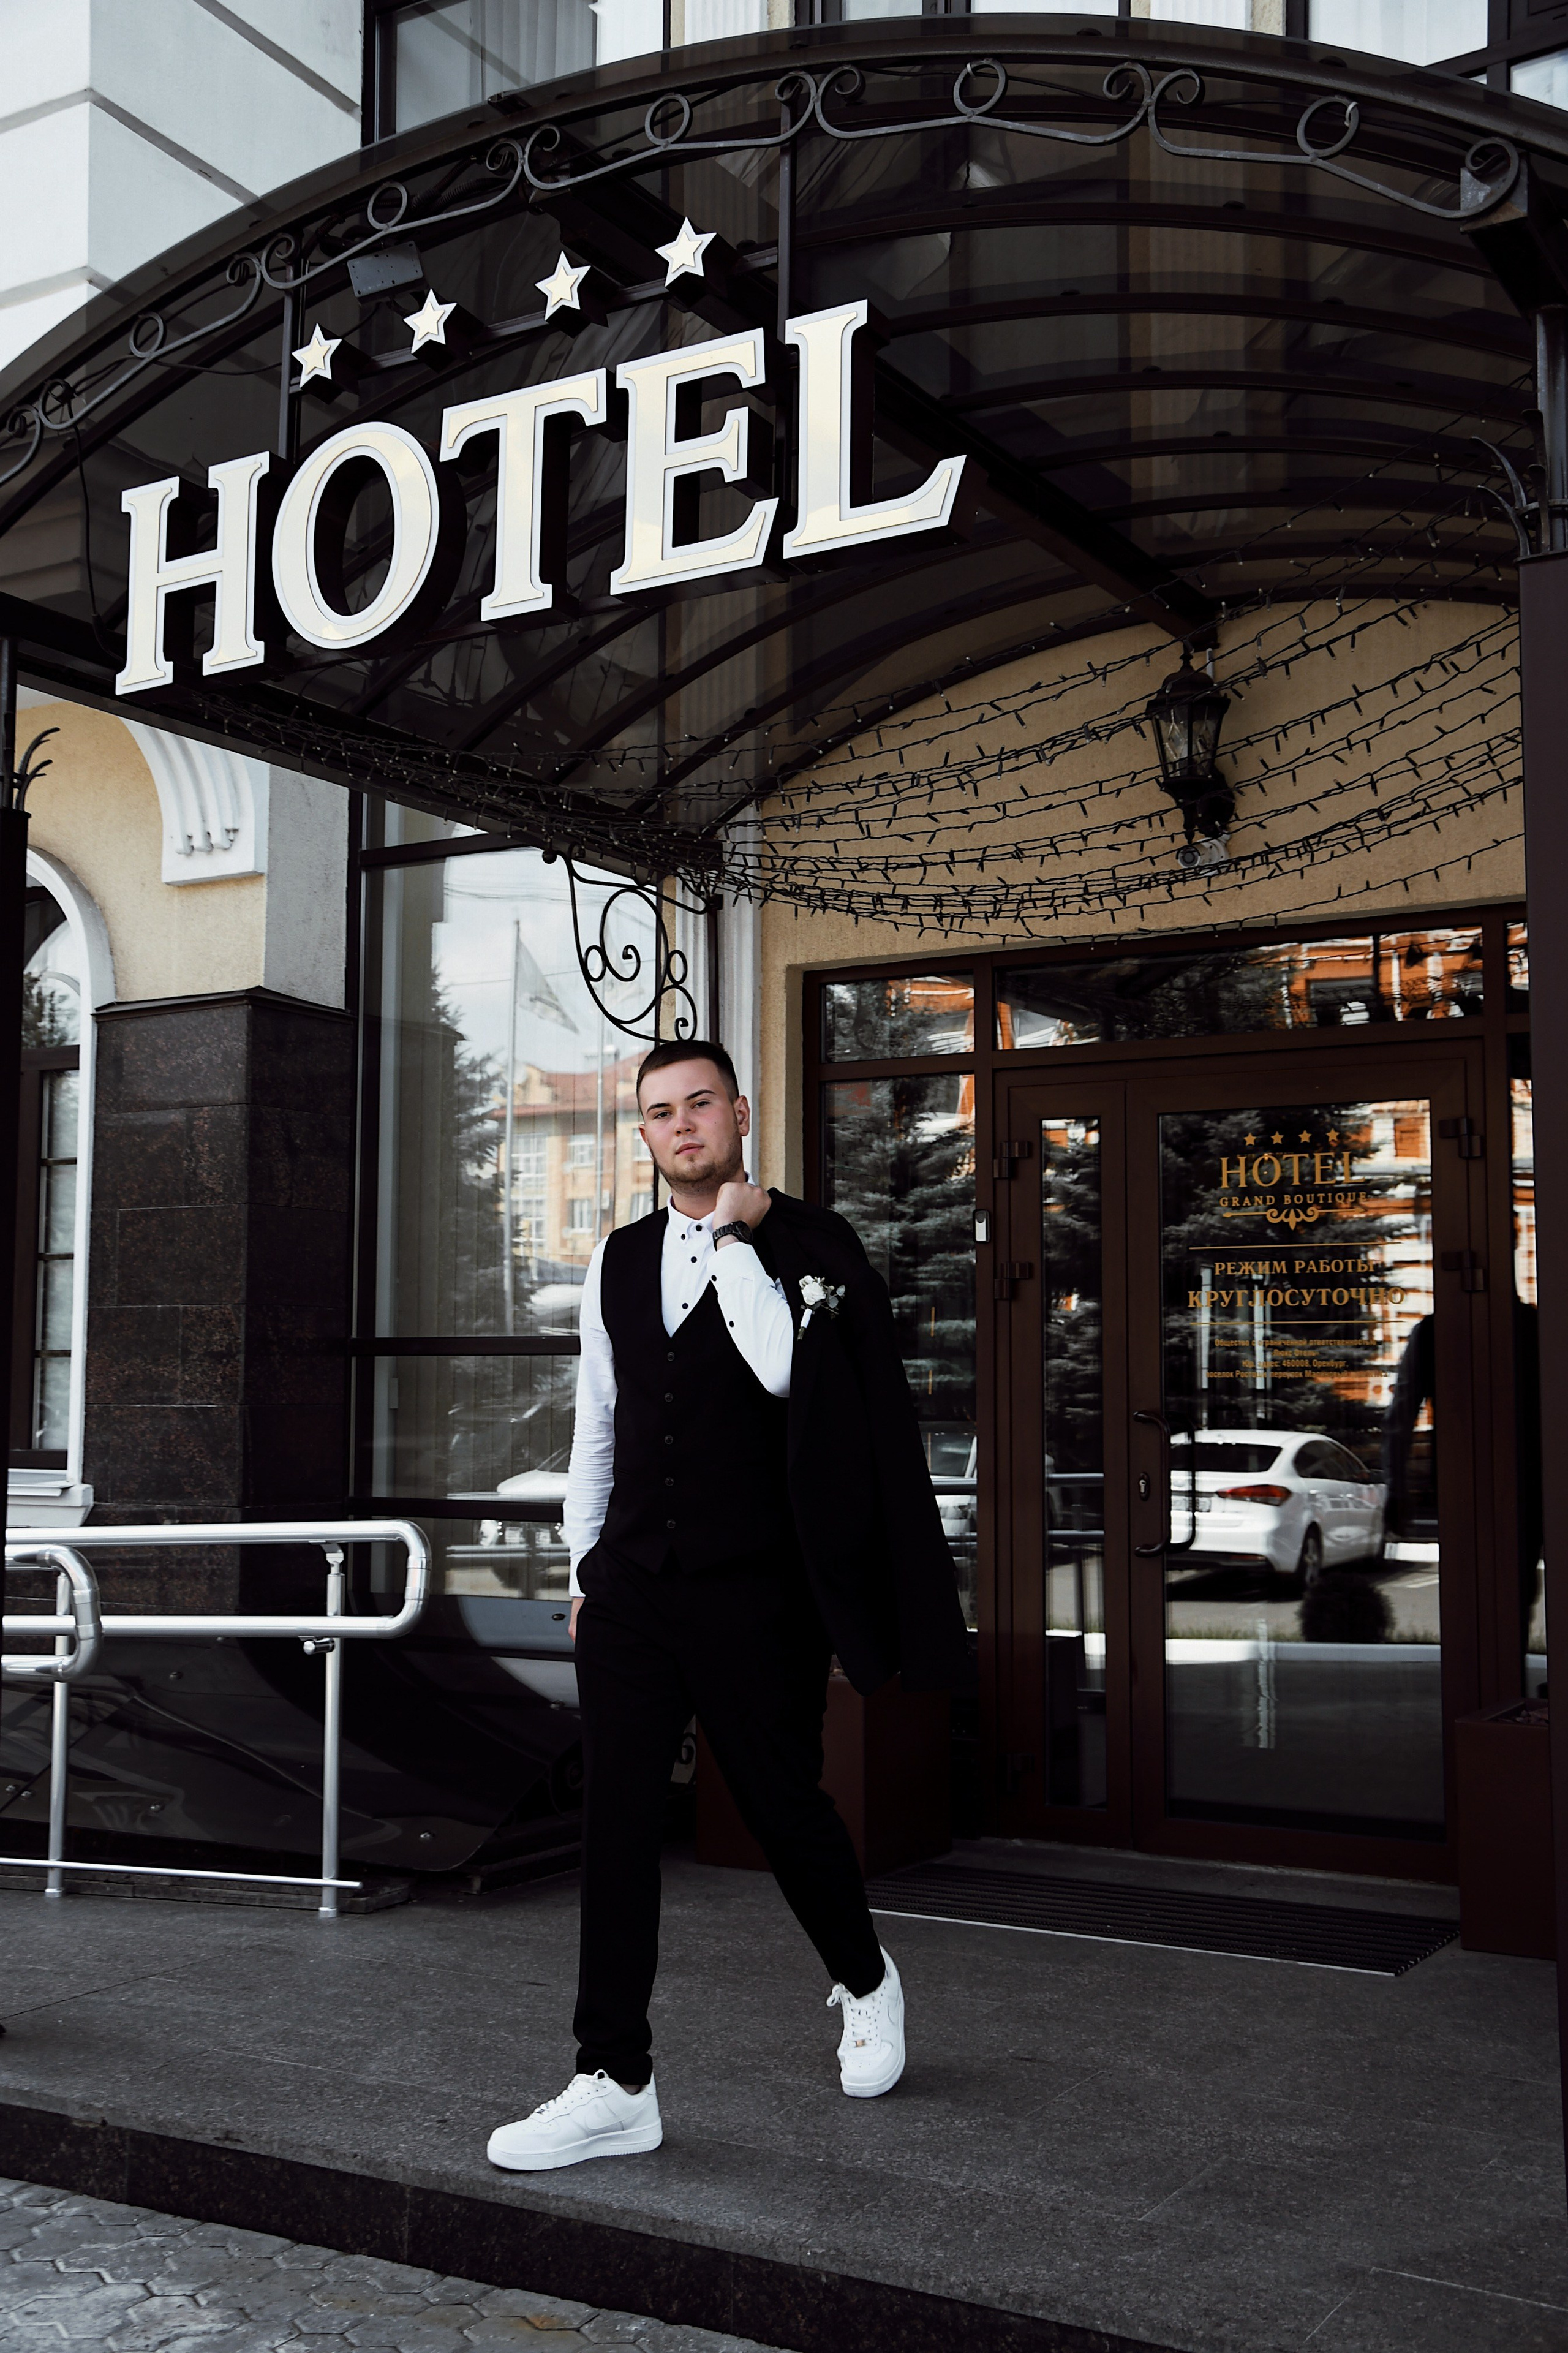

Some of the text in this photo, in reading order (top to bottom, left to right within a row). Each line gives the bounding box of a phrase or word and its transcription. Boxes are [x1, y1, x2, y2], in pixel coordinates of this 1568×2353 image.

[115, 299, 967, 695] HOTEL
[1220, 1151, 1366, 1188] HOTEL
[1219, 1192, 1368, 1207] GRAND BOUTIQUE
[1214, 1258, 1376, 1275] РЕЖИМ РАБОТЫ
[1188, 1286, 1406, 1308] КРУГЛОСУТОЧНО
[1258, 1339, 1307, 1347] ограниченной
